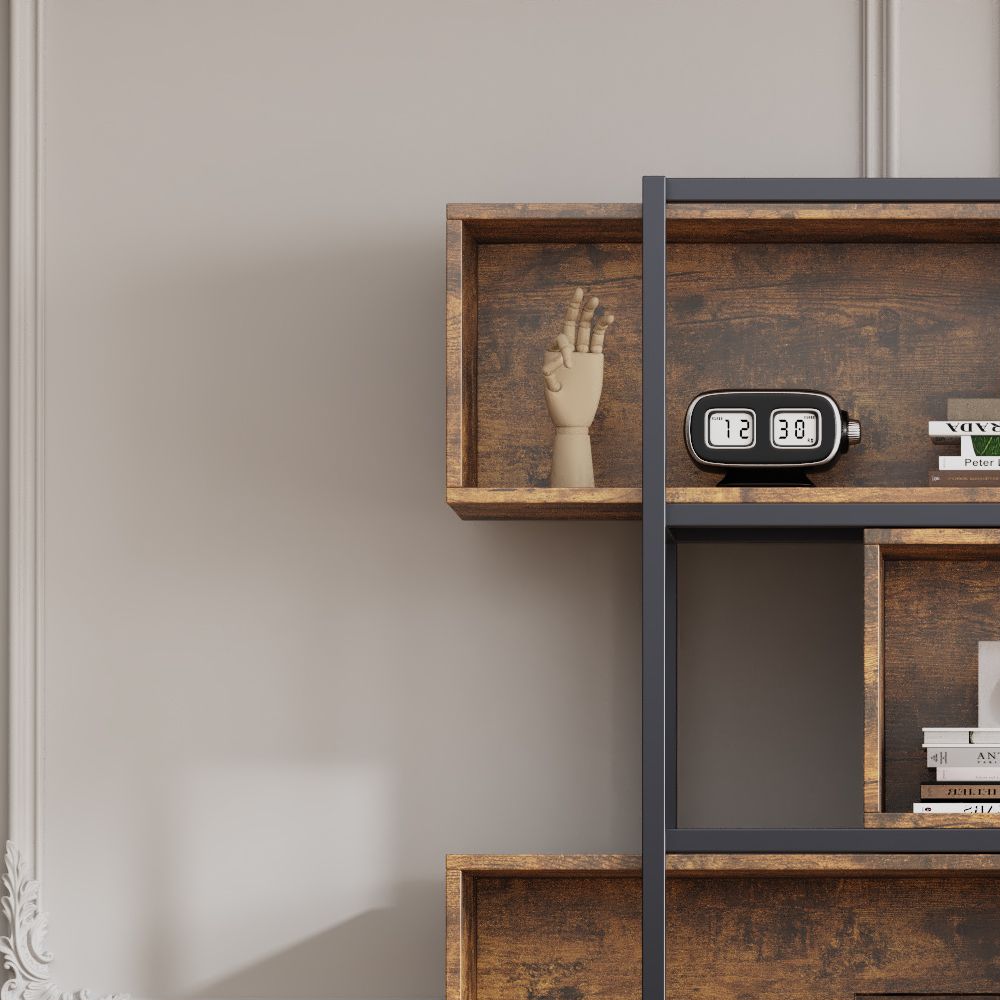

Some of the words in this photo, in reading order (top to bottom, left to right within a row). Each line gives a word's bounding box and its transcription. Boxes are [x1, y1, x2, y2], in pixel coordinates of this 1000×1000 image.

[725, 419, 750, 439] 12
[778, 419, 805, 439] 30
[965, 458, 994, 467] Peter
